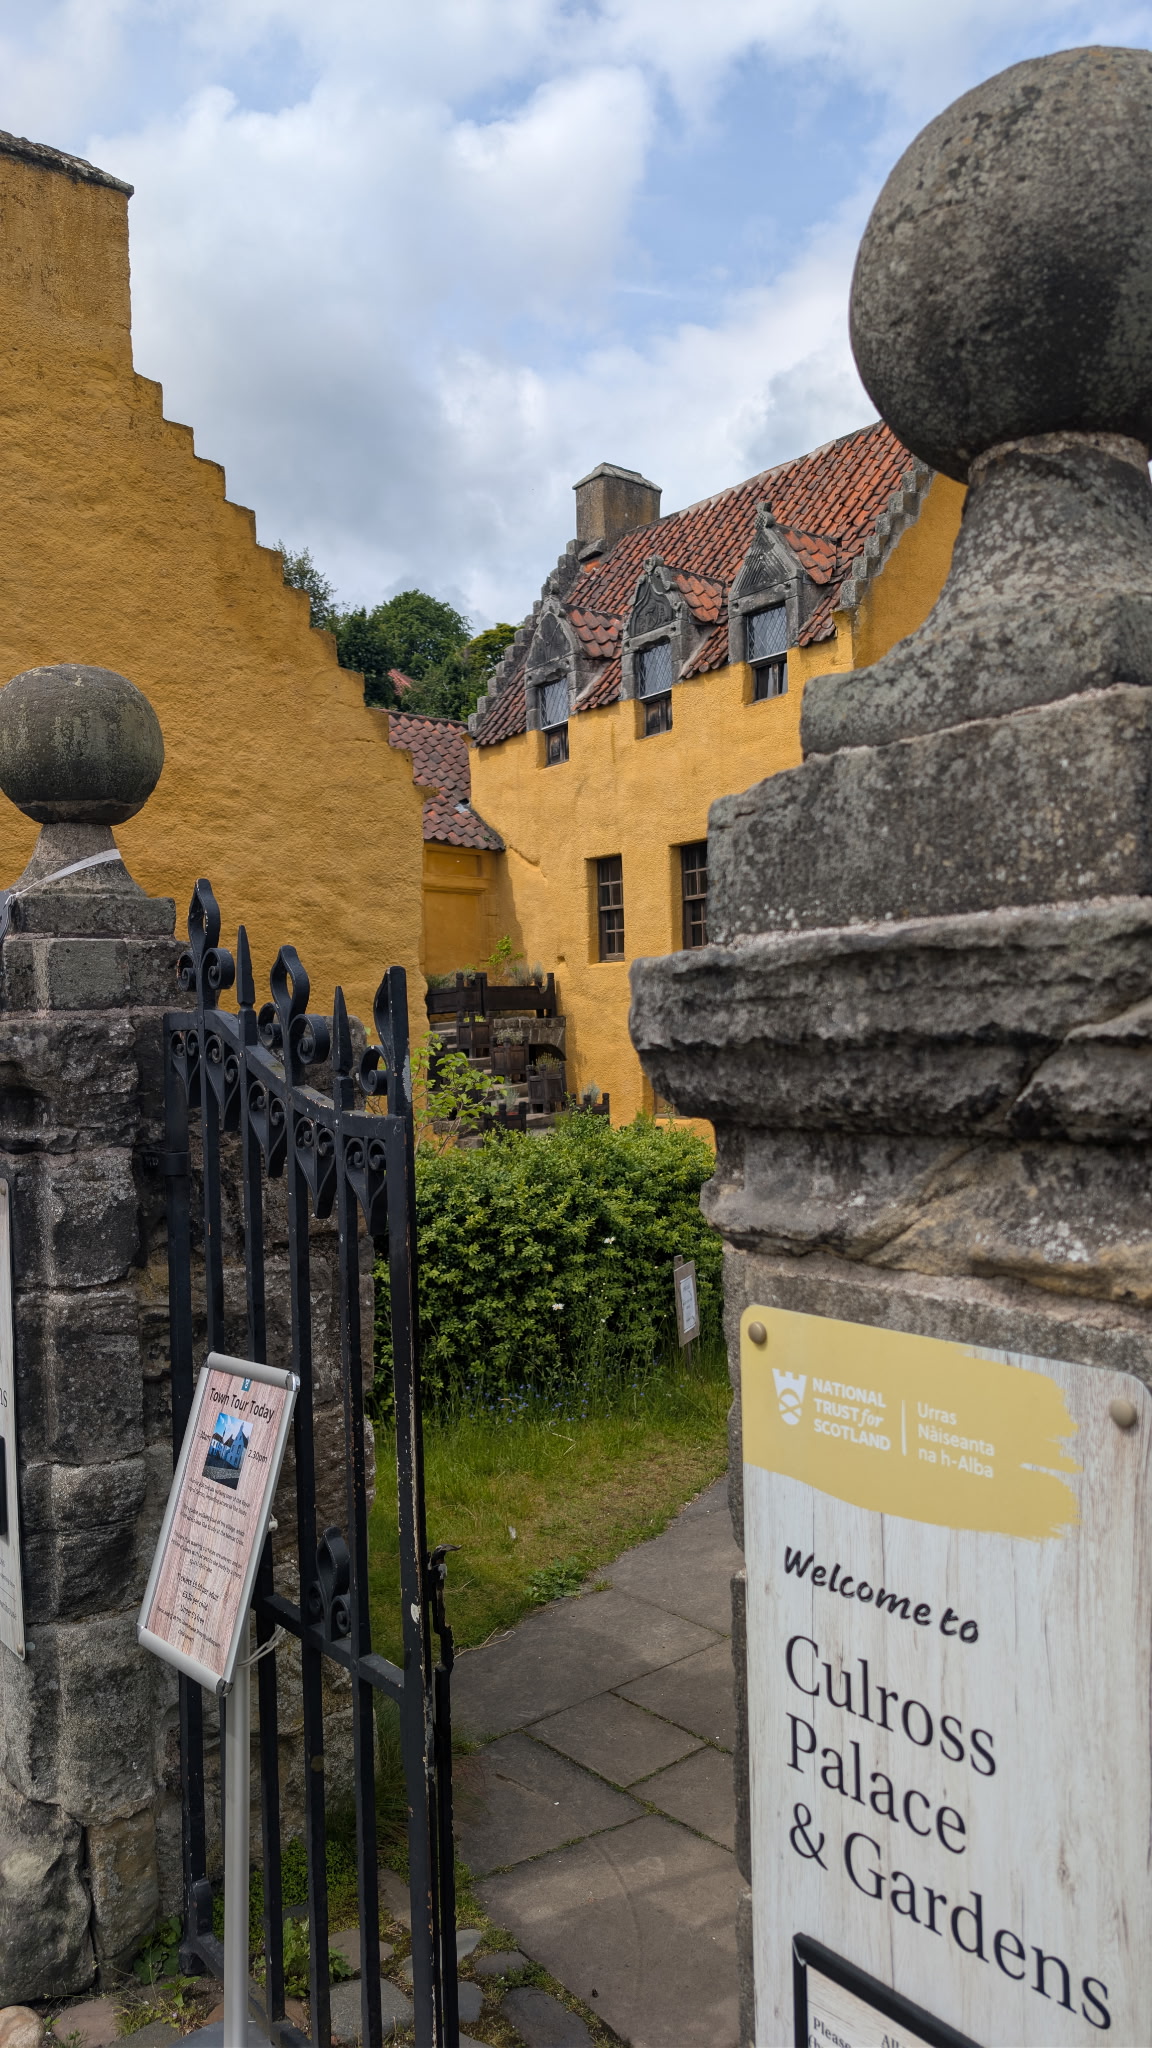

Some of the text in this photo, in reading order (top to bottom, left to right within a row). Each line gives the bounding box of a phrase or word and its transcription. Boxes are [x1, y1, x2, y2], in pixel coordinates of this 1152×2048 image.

[209, 1387, 275, 1424] Town Tour Today
[811, 1377, 887, 1409] NATIONAL
[813, 1398, 884, 1428] TRUST for
[917, 1402, 957, 1426] Urras
[813, 1419, 891, 1451] SCOTLAND
[917, 1423, 995, 1457] Nàiseanta
[248, 1449, 268, 1464] 2.30pm
[918, 1448, 994, 1479] na h-Alba
[783, 1545, 980, 1644] Welcome to
[785, 1635, 997, 1777] Culross
[785, 1712, 967, 1855] Palace
[789, 1802, 1112, 2031] & Gardens
